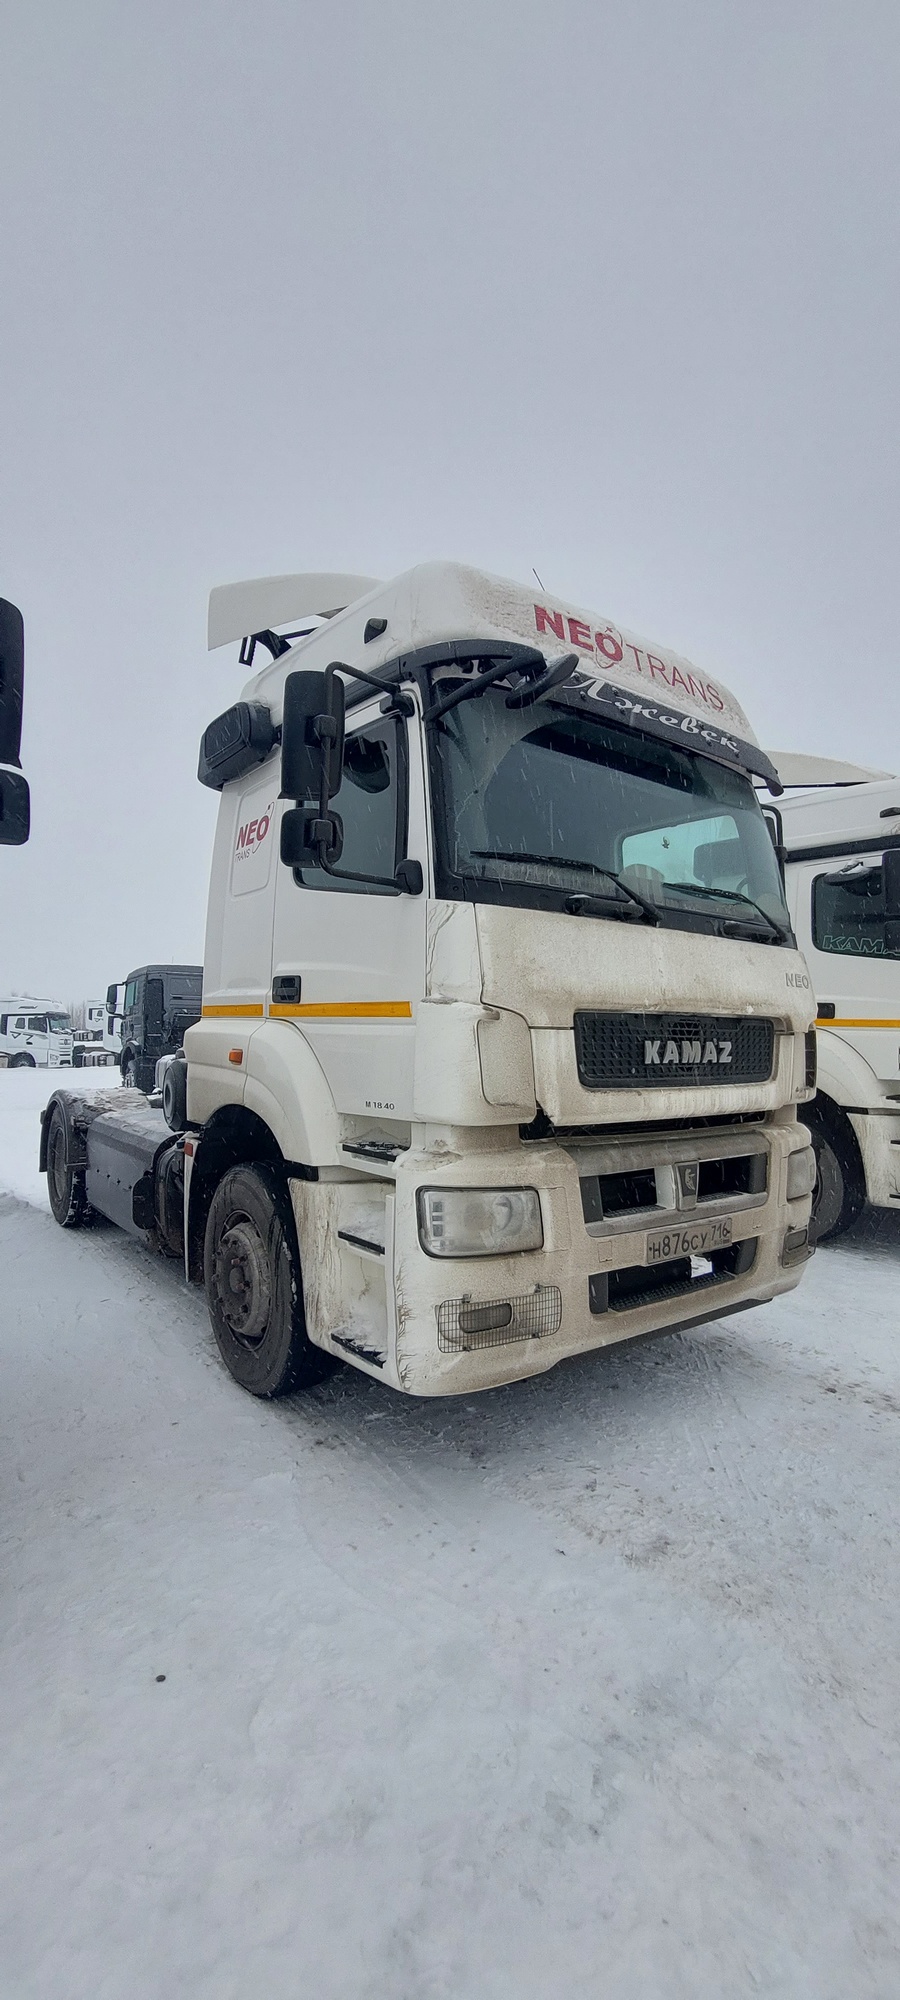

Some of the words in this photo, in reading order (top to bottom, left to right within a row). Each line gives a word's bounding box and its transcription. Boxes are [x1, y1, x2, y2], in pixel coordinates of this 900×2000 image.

[534, 604, 623, 662] NEO
[626, 643, 725, 711] TRANS
[236, 815, 270, 850] NEO
[822, 935, 900, 956] KAM
[785, 973, 809, 989] NEO
[644, 1039, 733, 1065] KAMAZ
[711, 1222, 730, 1241] 716
